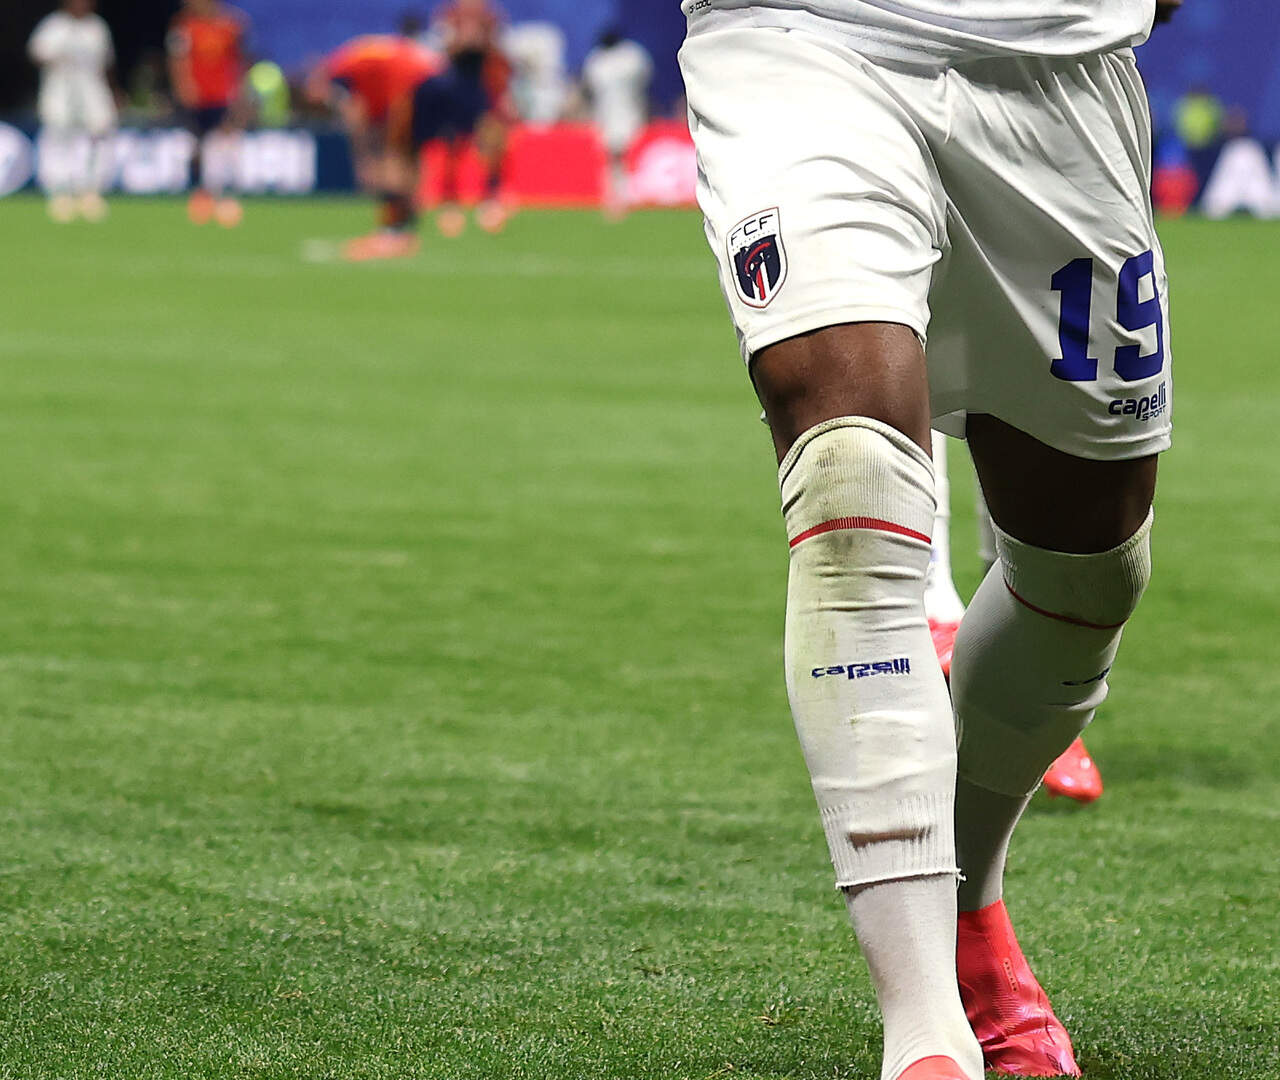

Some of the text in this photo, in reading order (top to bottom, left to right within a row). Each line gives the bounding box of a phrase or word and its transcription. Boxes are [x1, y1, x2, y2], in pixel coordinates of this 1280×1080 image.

[731, 214, 773, 246] FCF
[1050, 249, 1164, 382] 19
[1109, 381, 1166, 420] capelli
